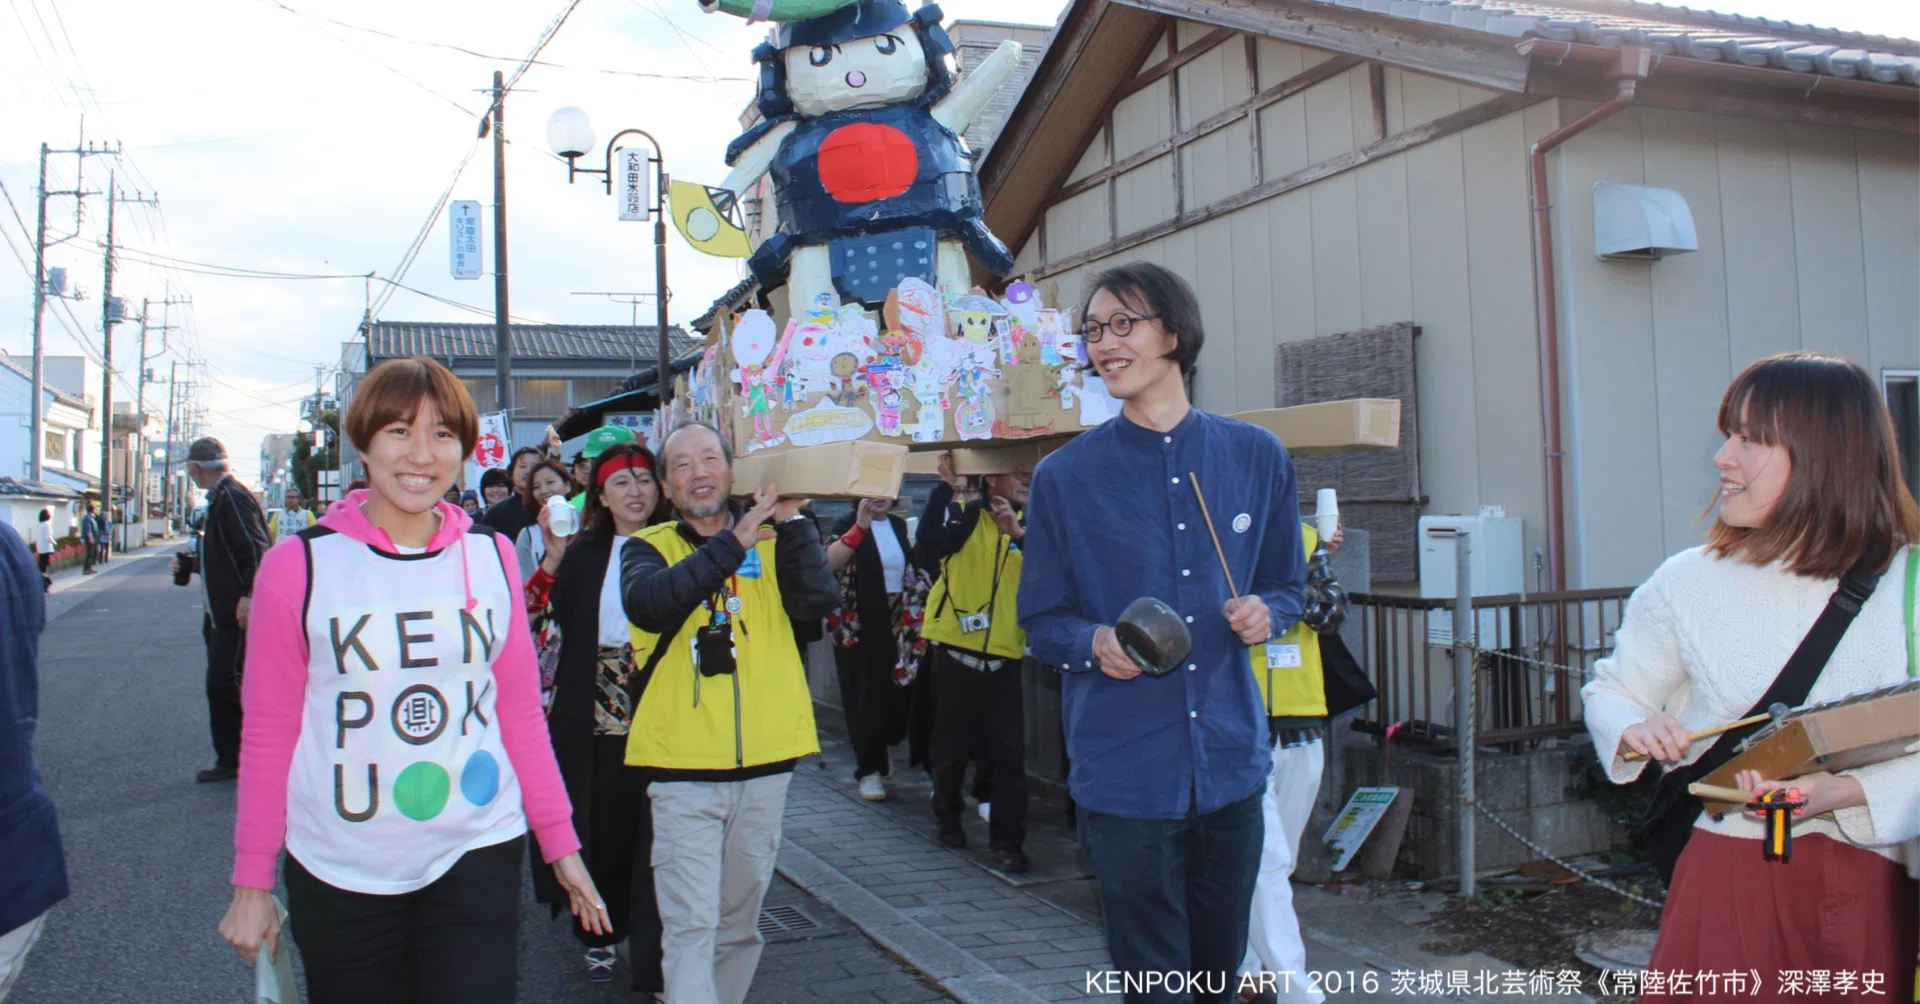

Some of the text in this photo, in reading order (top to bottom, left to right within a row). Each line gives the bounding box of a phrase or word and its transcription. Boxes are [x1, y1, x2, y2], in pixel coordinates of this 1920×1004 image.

[626, 152, 640, 214] 大和田米穀店
[329, 608, 497, 675] KEN
[333, 762, 380, 823] U
